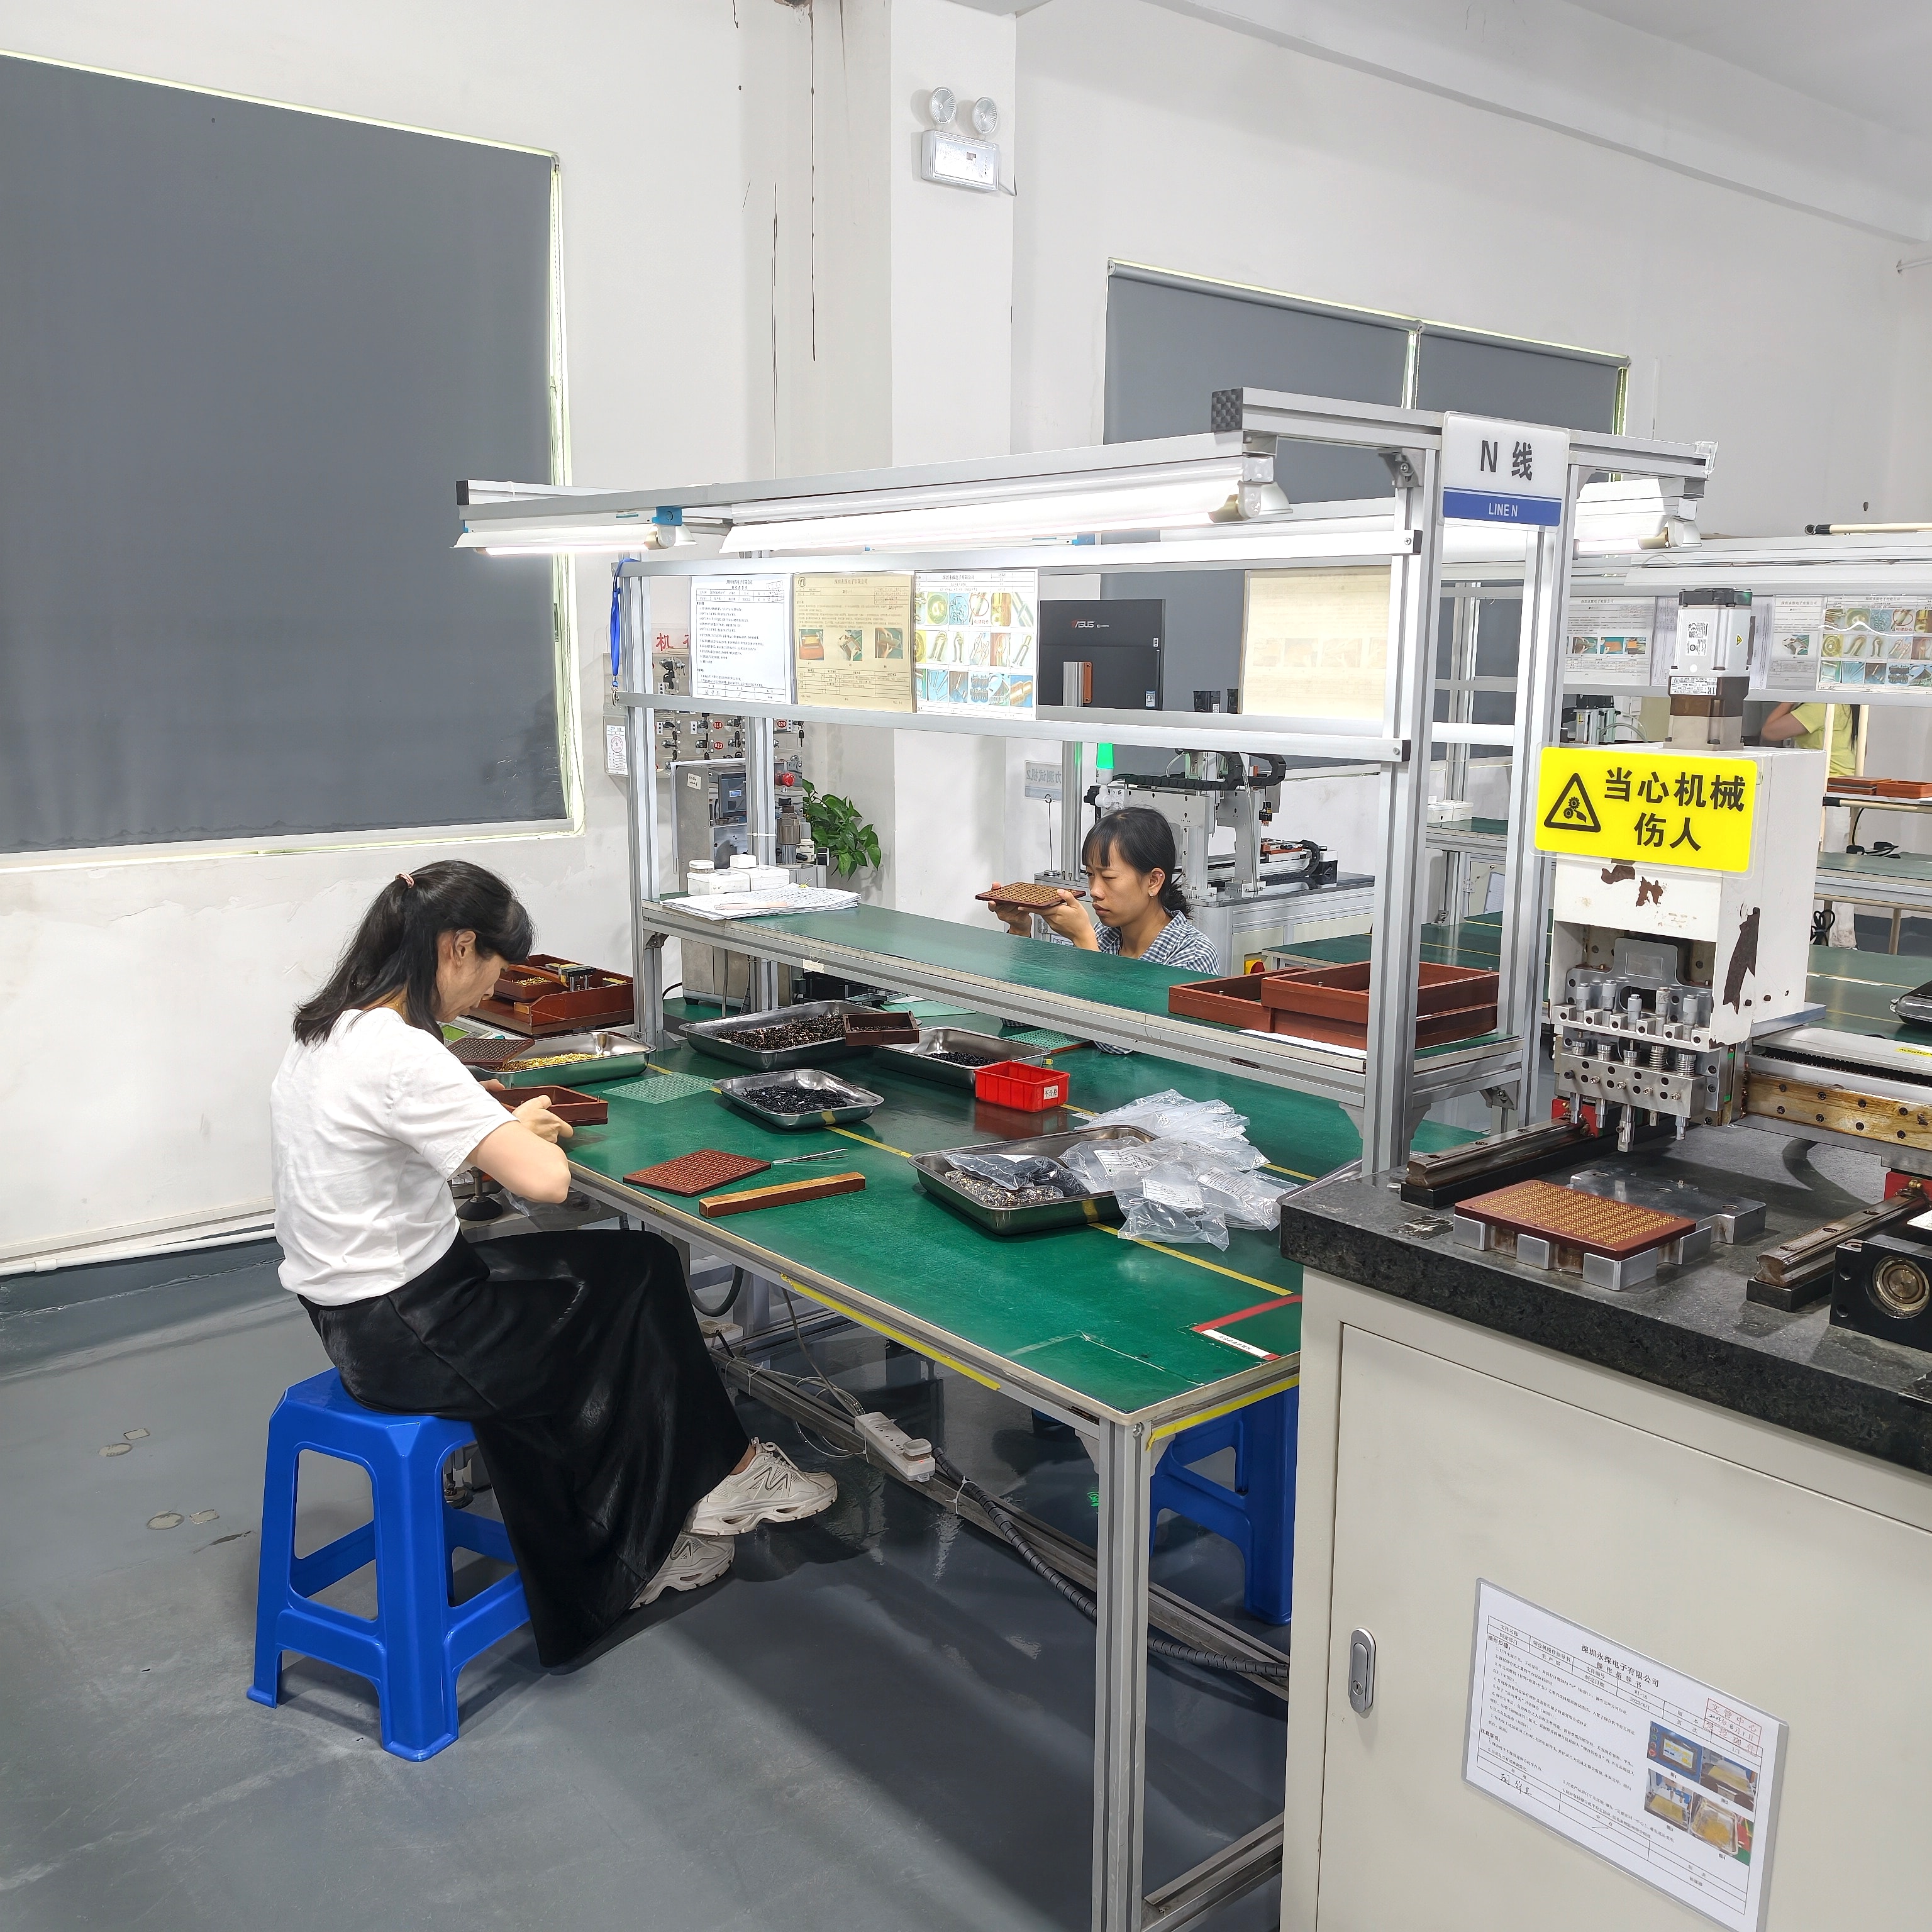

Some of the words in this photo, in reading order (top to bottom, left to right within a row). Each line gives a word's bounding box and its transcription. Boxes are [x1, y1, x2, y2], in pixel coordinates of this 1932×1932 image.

[1480, 440, 1498, 472] N
[1511, 441, 1533, 480] 线
[1489, 502, 1509, 516] LINE
[1511, 504, 1518, 517] N
[1604, 767, 1746, 812] 当心机械
[1634, 812, 1702, 852] 伤人
[1581, 1644, 1659, 1688] 深圳永探电子有限公司
